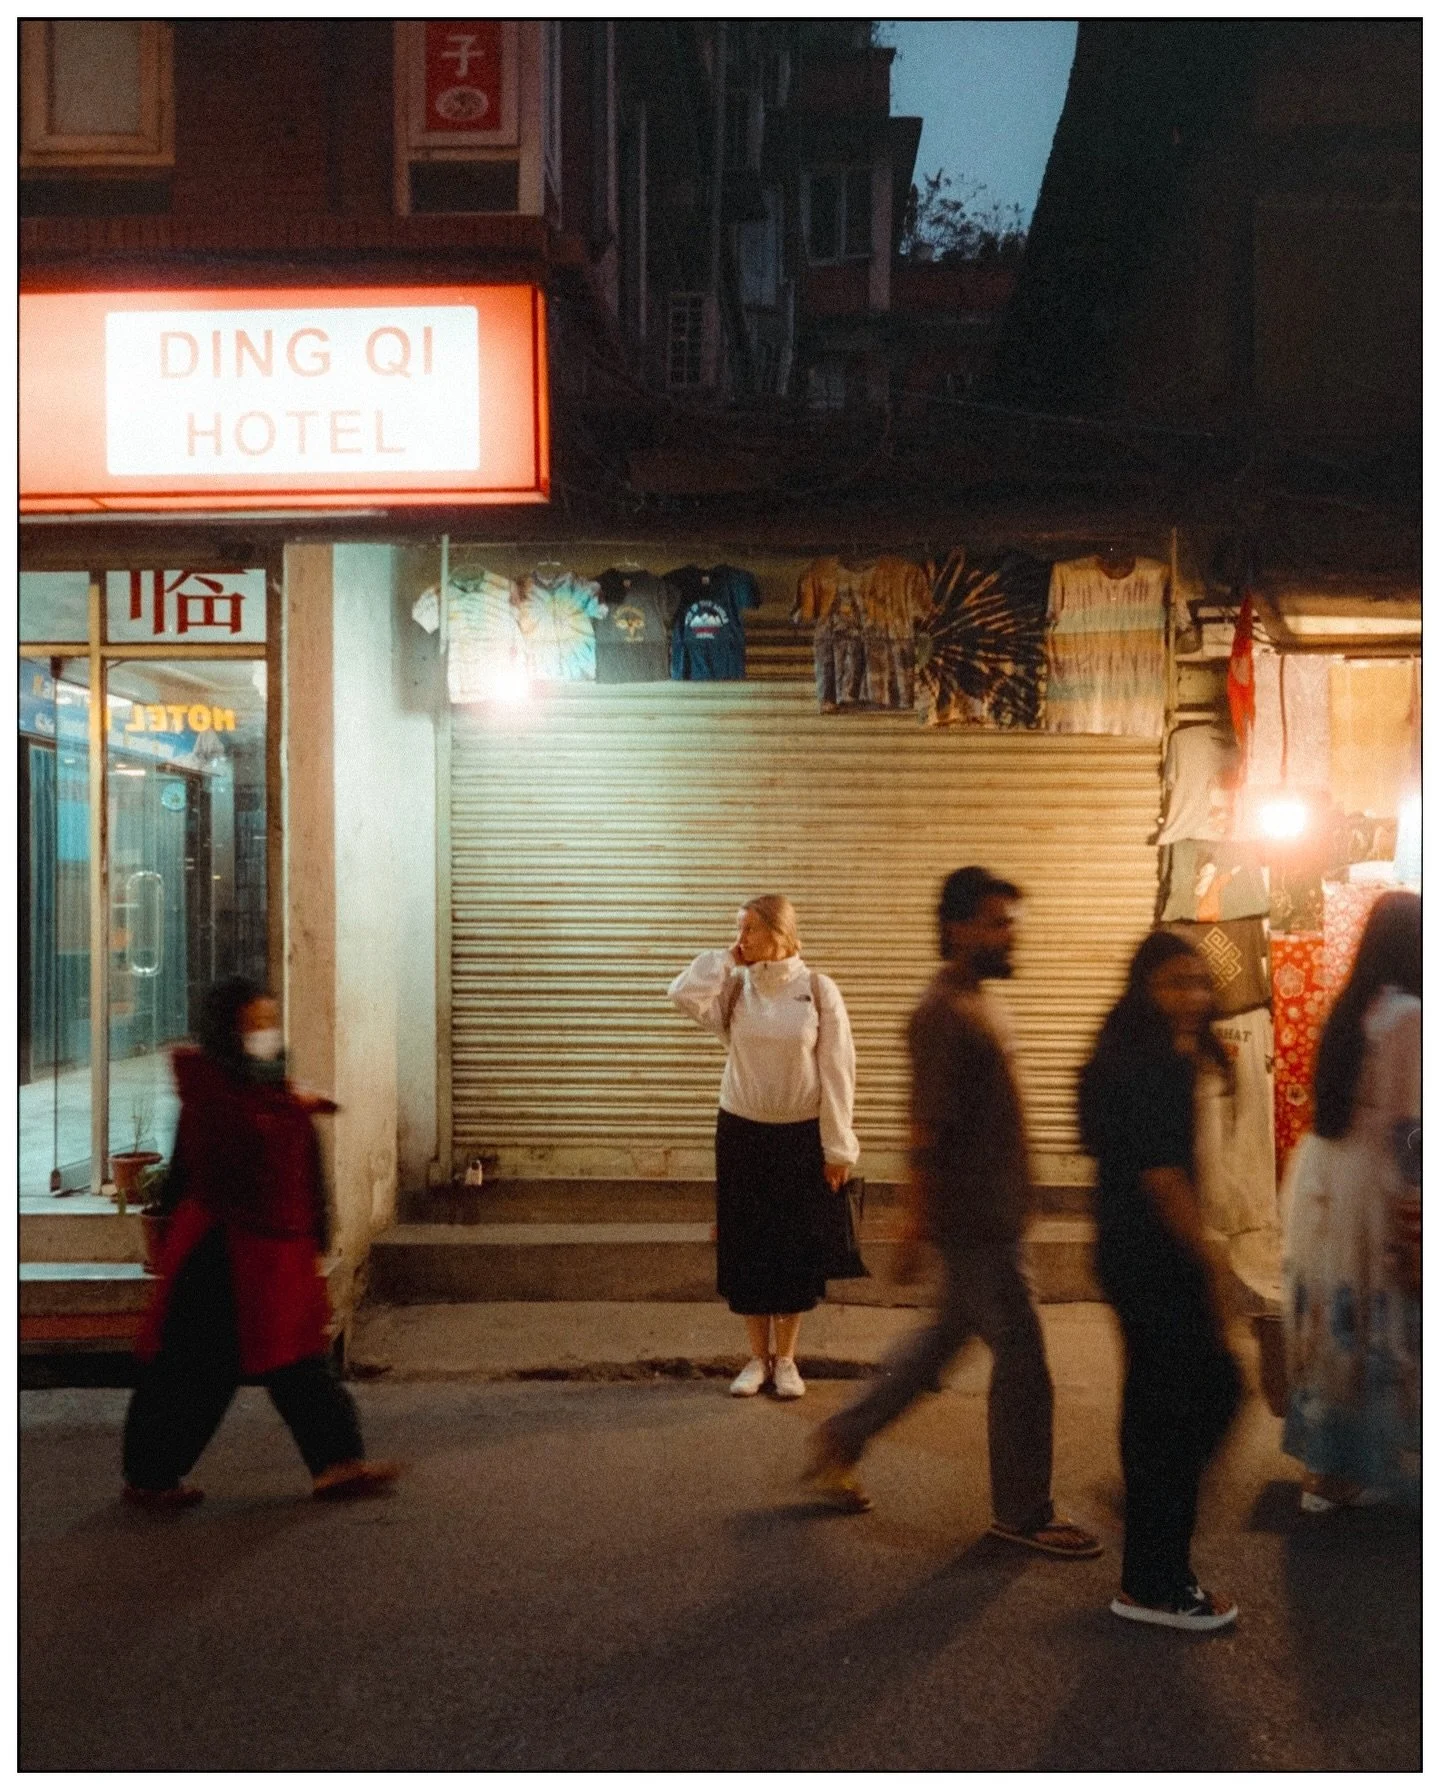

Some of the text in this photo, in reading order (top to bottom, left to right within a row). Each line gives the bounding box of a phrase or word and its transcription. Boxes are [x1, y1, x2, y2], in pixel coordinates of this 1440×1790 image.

[441, 34, 485, 77] 子
[160, 325, 433, 379] DING QI
[187, 410, 406, 456] HOTEL
